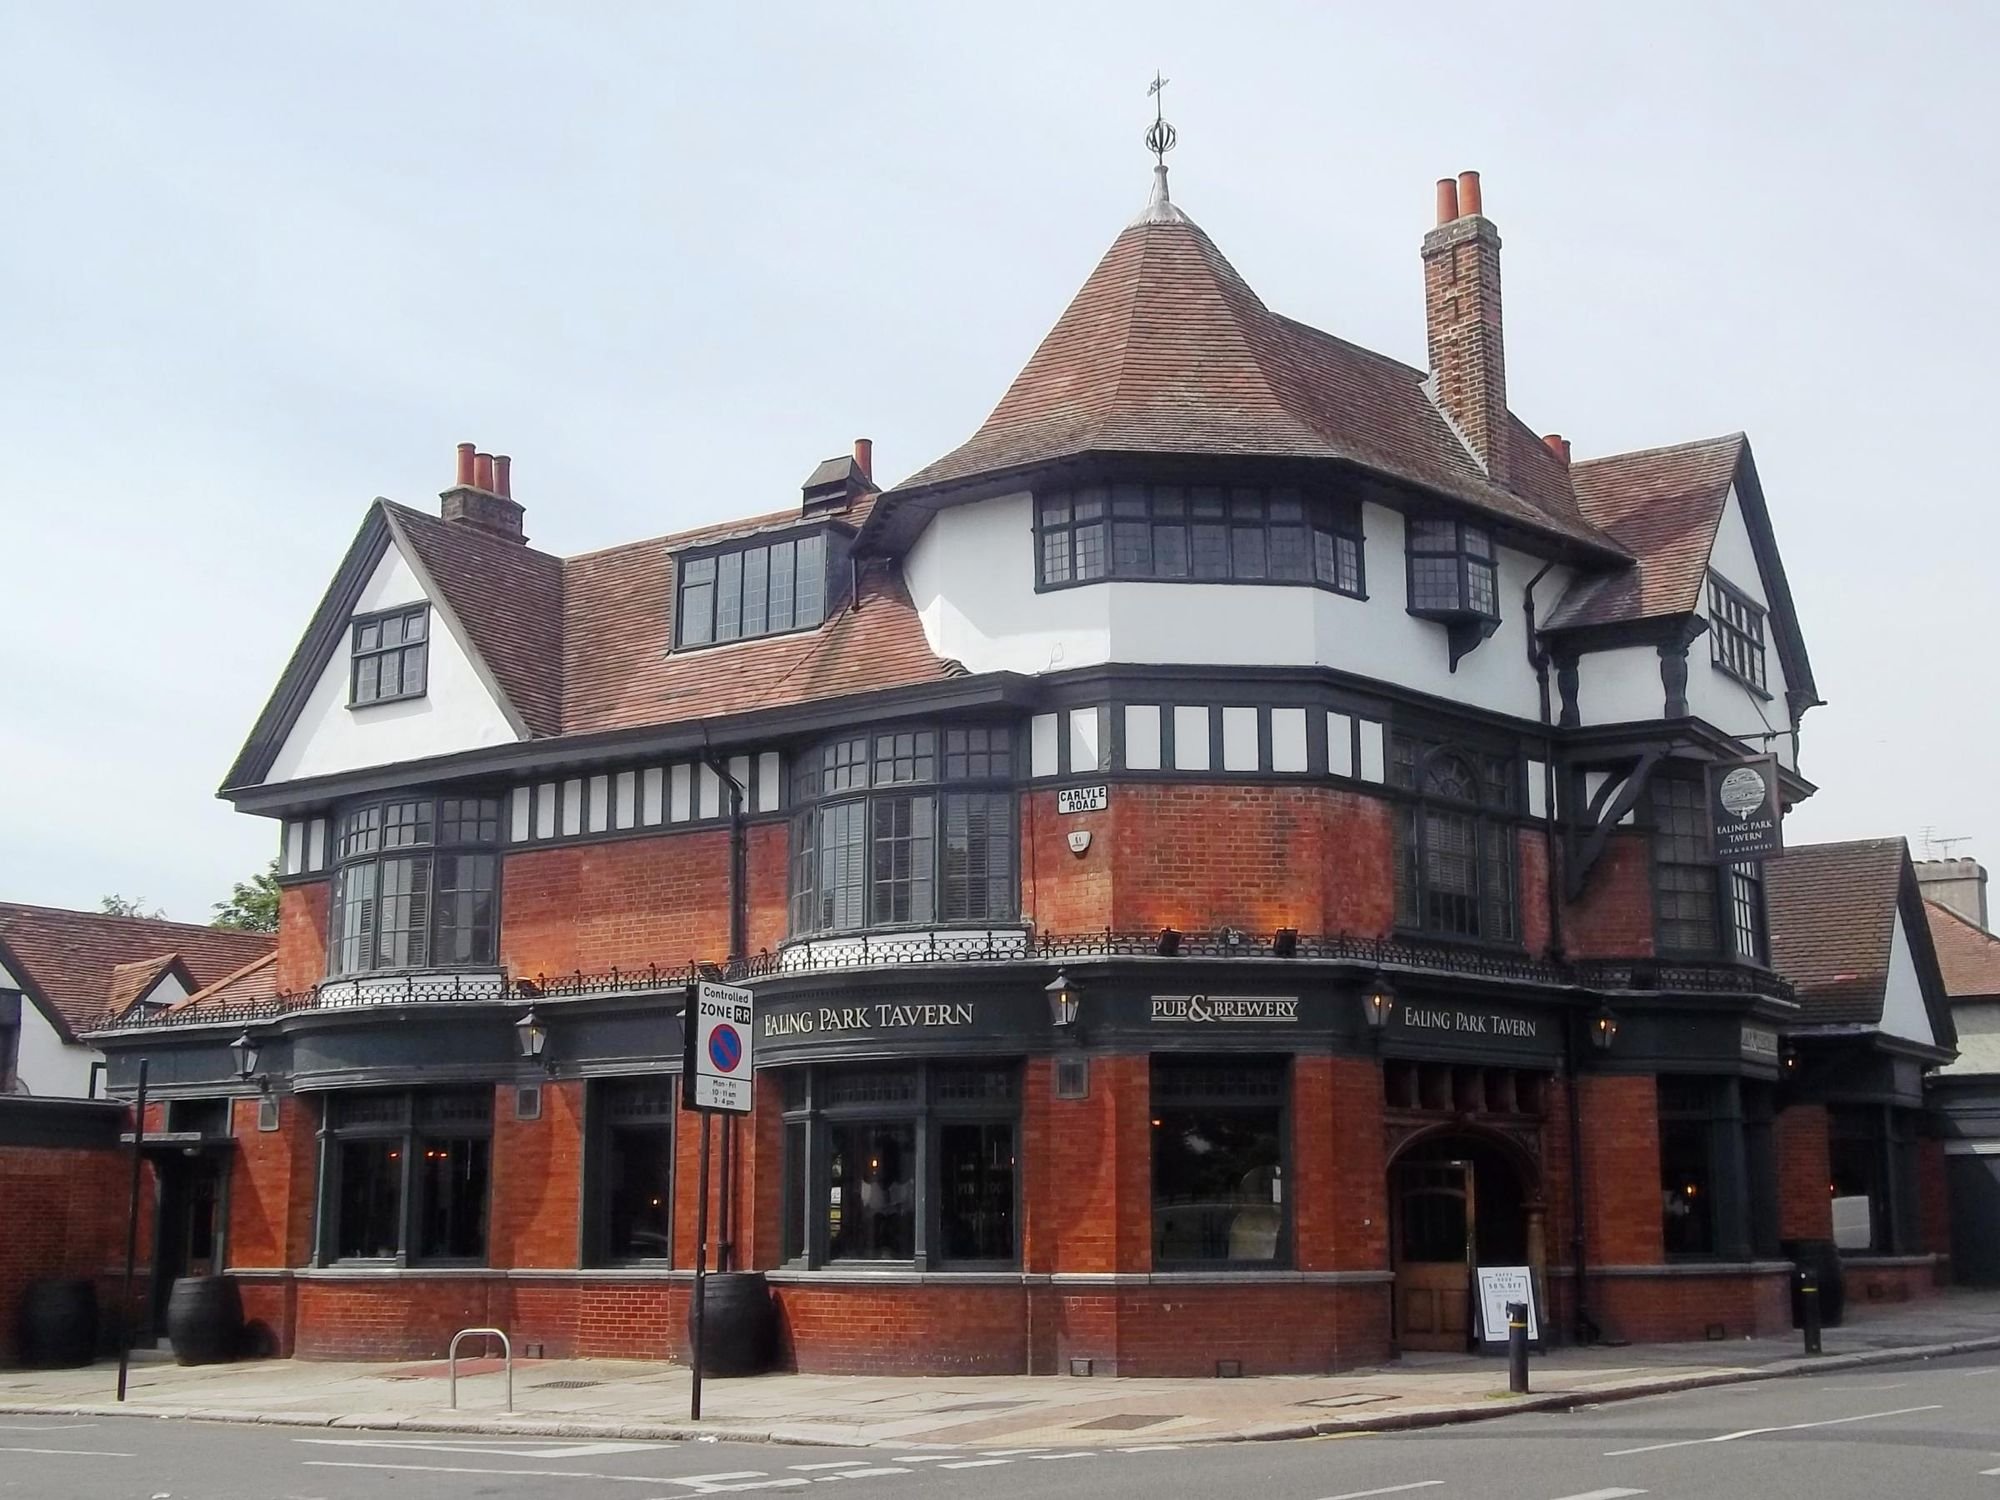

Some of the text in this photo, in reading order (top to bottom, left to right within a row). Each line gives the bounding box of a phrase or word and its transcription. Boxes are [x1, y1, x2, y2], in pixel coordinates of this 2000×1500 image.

[1060, 787, 1105, 802] CARLYLE
[1750, 819, 1773, 831] PARK
[1729, 832, 1762, 843] TAVERN
[1741, 843, 1773, 852] BREWERY
[703, 986, 749, 1004] Controlled
[700, 1002, 751, 1024] ZONE RR
[763, 1003, 974, 1037] EALING PARK TAVERN
[1404, 1006, 1537, 1037] EALING PARK TAVERN
